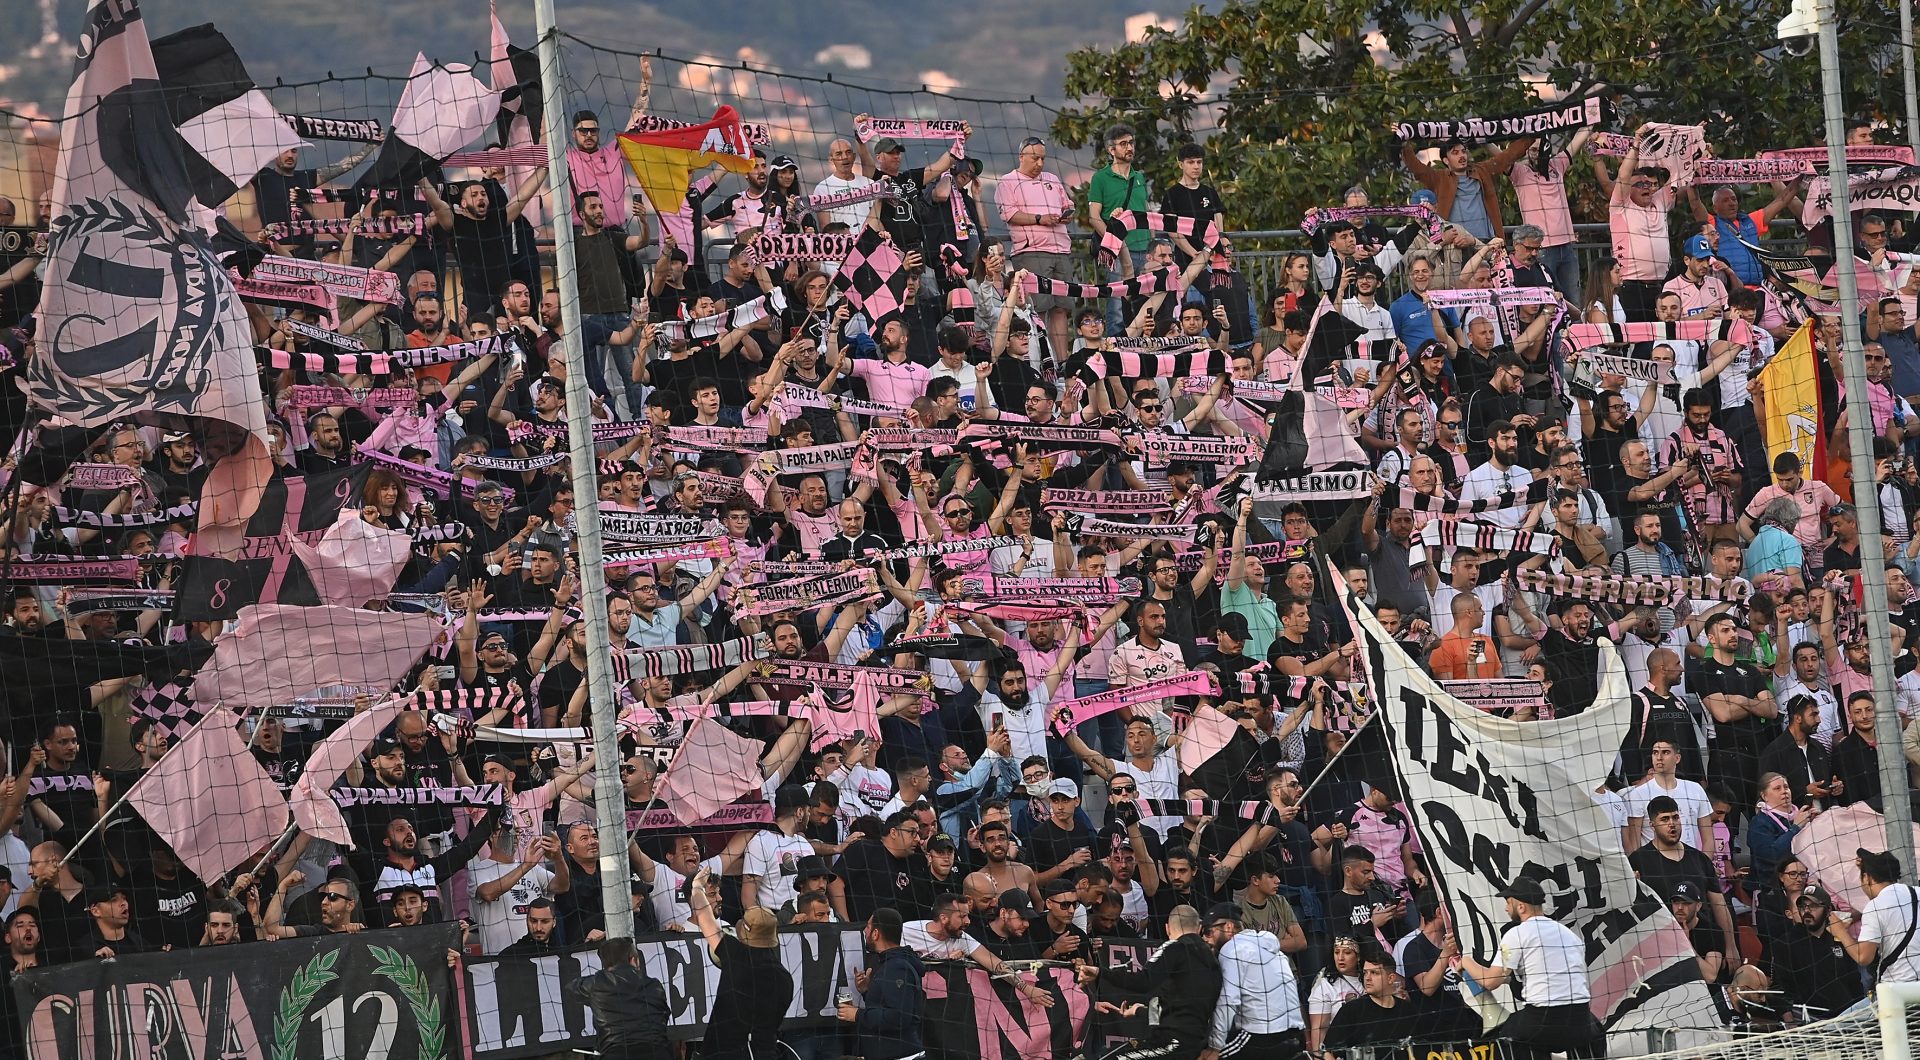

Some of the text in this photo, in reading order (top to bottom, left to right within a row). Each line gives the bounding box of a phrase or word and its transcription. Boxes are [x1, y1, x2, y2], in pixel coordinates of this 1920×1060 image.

[303, 117, 383, 142] TERRONE
[873, 121, 963, 130] FORZA PALERM
[1418, 120, 1452, 141] CHE
[1702, 159, 1807, 177] FORZA PALERMO
[809, 182, 881, 206] PALERMO
[761, 236, 809, 256] ORZA
[1596, 355, 1659, 381] PALERMO
[375, 388, 416, 403] PALERM
[785, 387, 821, 402] FORZA
[846, 398, 892, 411] PALERMO
[787, 447, 857, 468] FORZA PALER
[1145, 441, 1248, 455] FORZA PALERMO
[75, 468, 132, 481] PALERM
[1257, 474, 1357, 493] PALERMO
[1049, 489, 1097, 503] FORZA
[55, 503, 199, 527] PALERM
[890, 536, 1015, 560] FORZA PALERMO
[49, 566, 111, 579] PALERMO
[797, 564, 826, 572] PALERMO
[210, 578, 231, 609] 8
[757, 574, 860, 603] FORZA PALERMO
[1523, 571, 1669, 602] PALERMO
[1143, 663, 1168, 680] Decò
